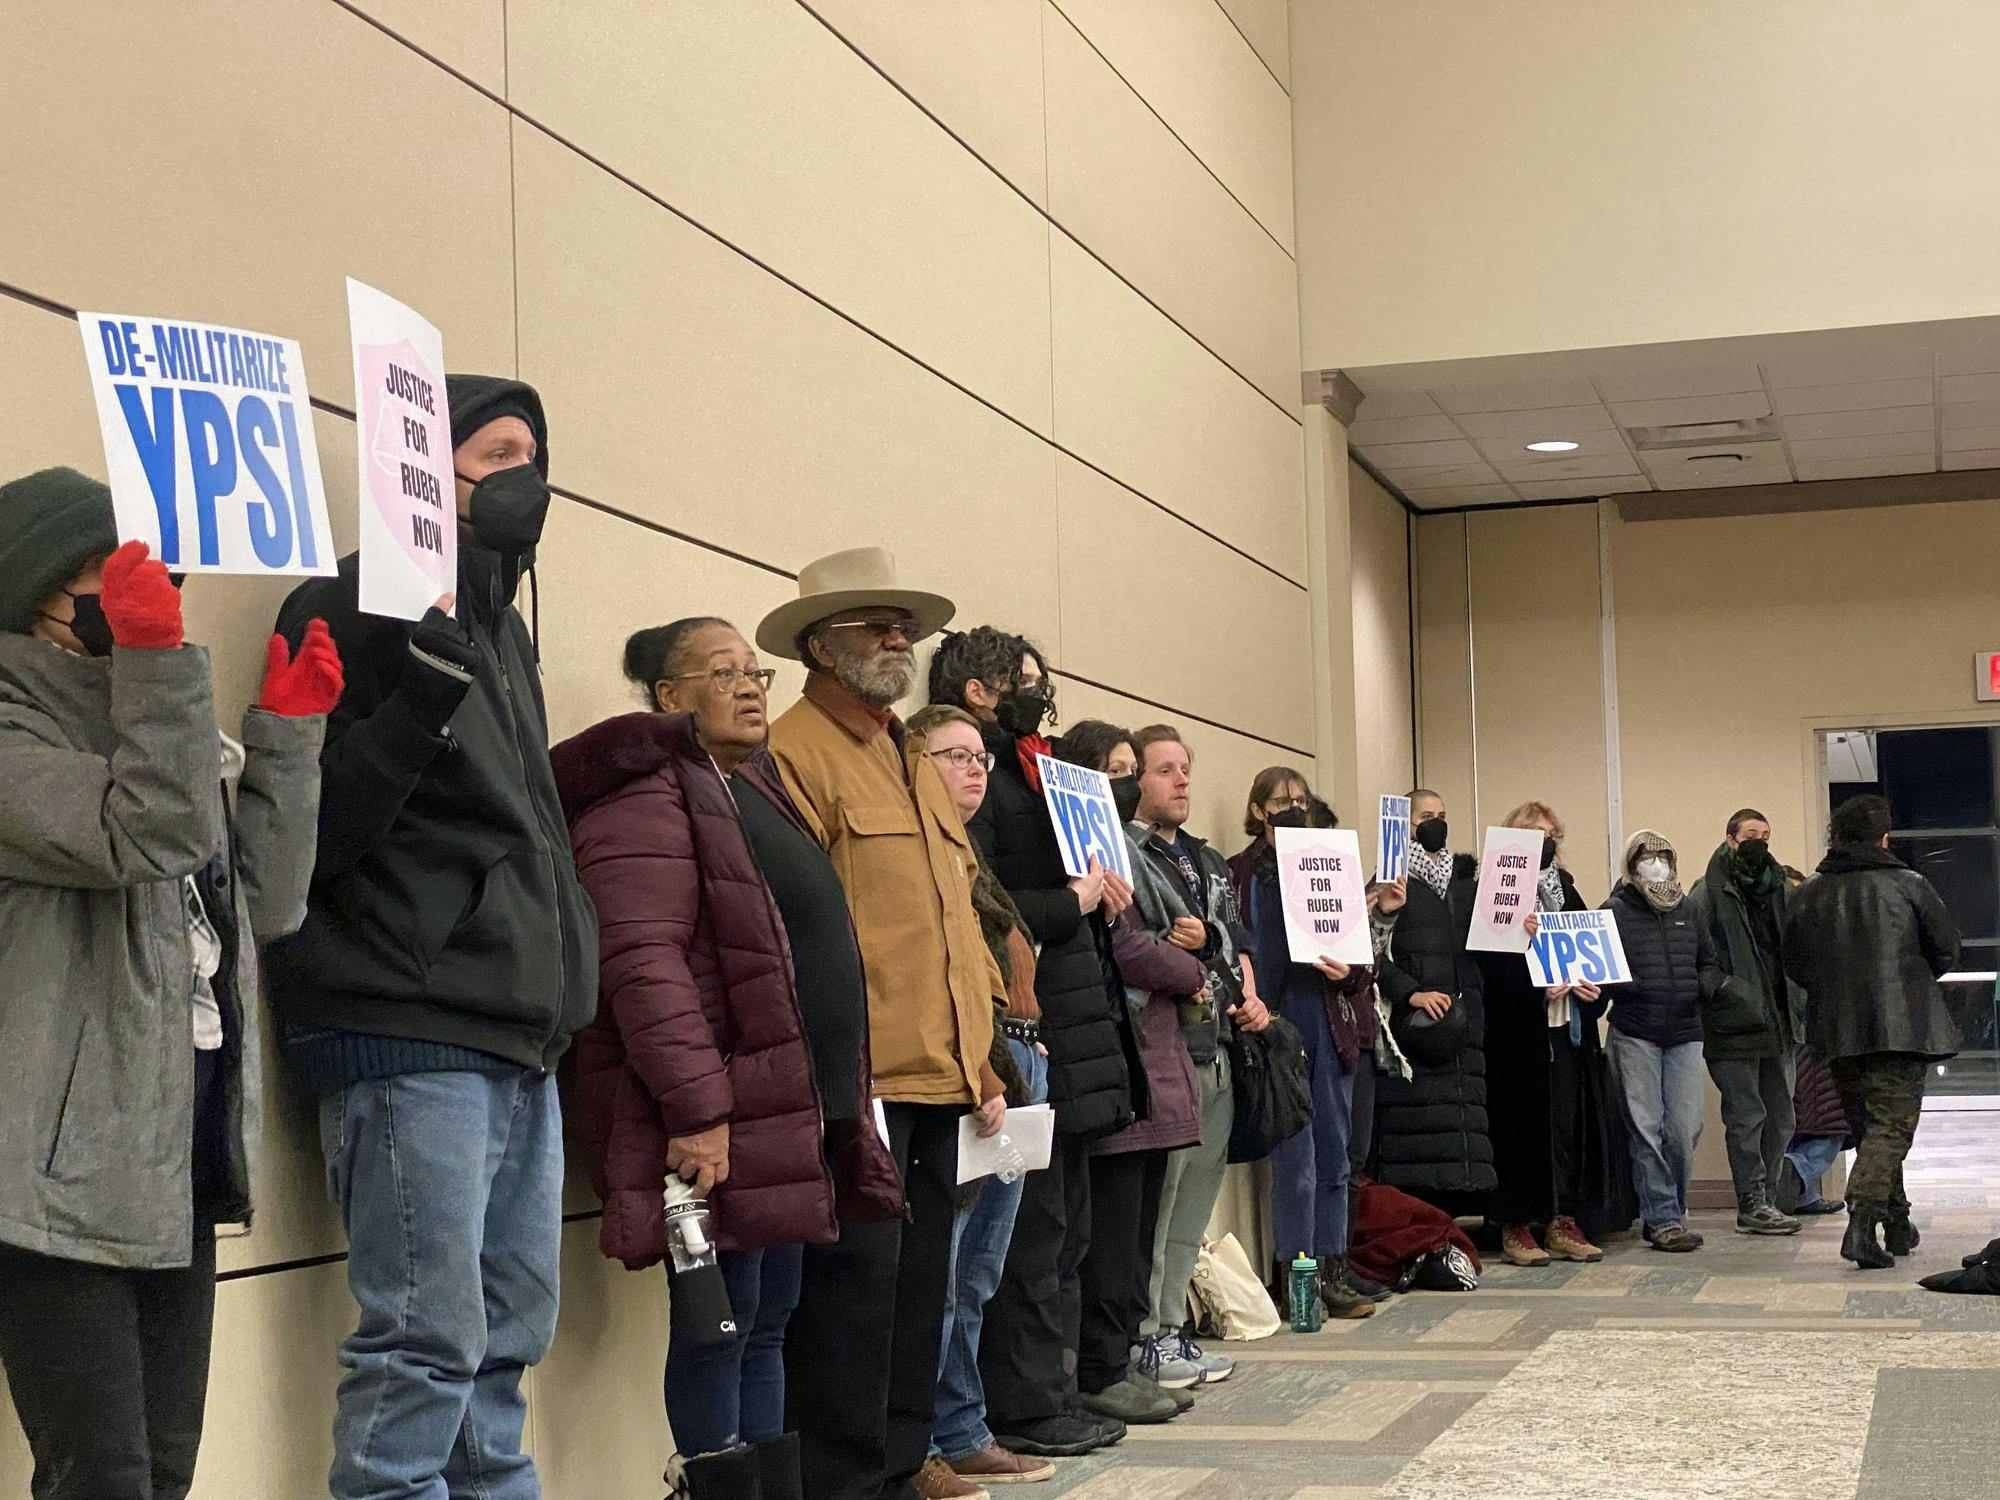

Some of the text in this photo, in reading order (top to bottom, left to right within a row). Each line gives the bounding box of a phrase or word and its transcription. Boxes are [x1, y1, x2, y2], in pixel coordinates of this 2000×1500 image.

[98, 319, 291, 394] DE-MILITARIZE
[386, 362, 435, 417] JUSTICE
[403, 416, 429, 457] FOR
[113, 384, 318, 569] YPSI
[400, 461, 442, 510] RUBEN
[412, 514, 443, 556] NOW
[1041, 758, 1106, 798] DE-MILITARIZE
[1049, 788, 1126, 879] YPSI
[1298, 857, 1342, 872] JUSTICE
[1497, 855, 1528, 869] JUSTICE
[1501, 874, 1517, 887] FOR
[1307, 898, 1343, 912] RUBEN
[1310, 878, 1332, 892] FOR
[1493, 893, 1520, 907] RUBEN
[1314, 919, 1340, 933] NOW
[1493, 911, 1514, 925] NOW
[1531, 929, 1621, 984] YPSI
